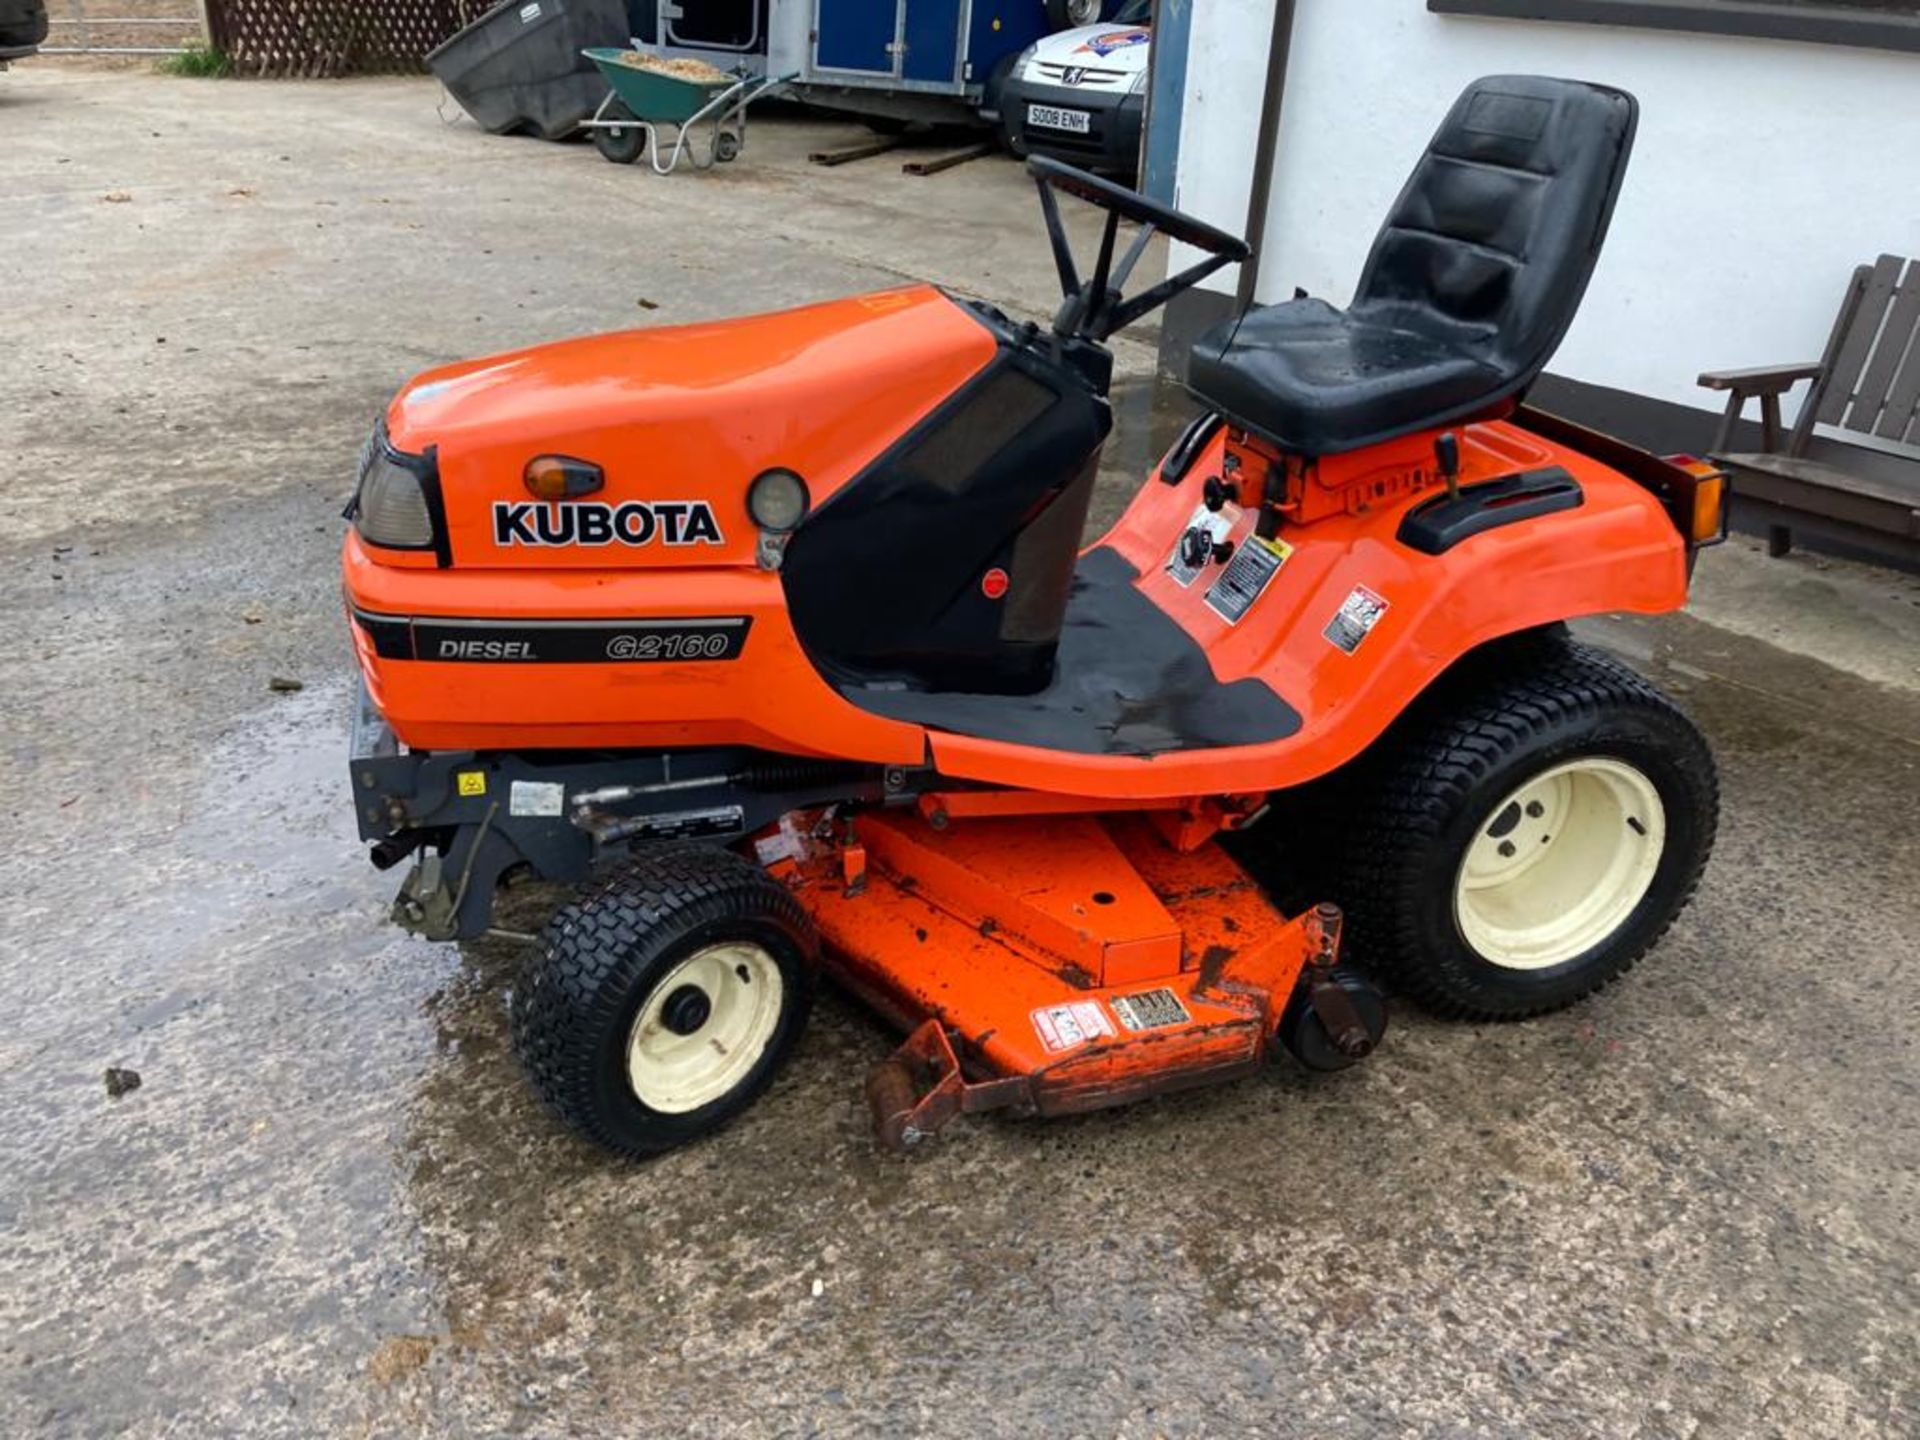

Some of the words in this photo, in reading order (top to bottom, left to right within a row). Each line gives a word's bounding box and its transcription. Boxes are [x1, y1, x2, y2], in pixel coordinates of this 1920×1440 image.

[1061, 111, 1085, 129] ENH
[493, 501, 723, 546] KUBOTA
[438, 640, 537, 660] DIESEL
[606, 634, 729, 660] G2160
